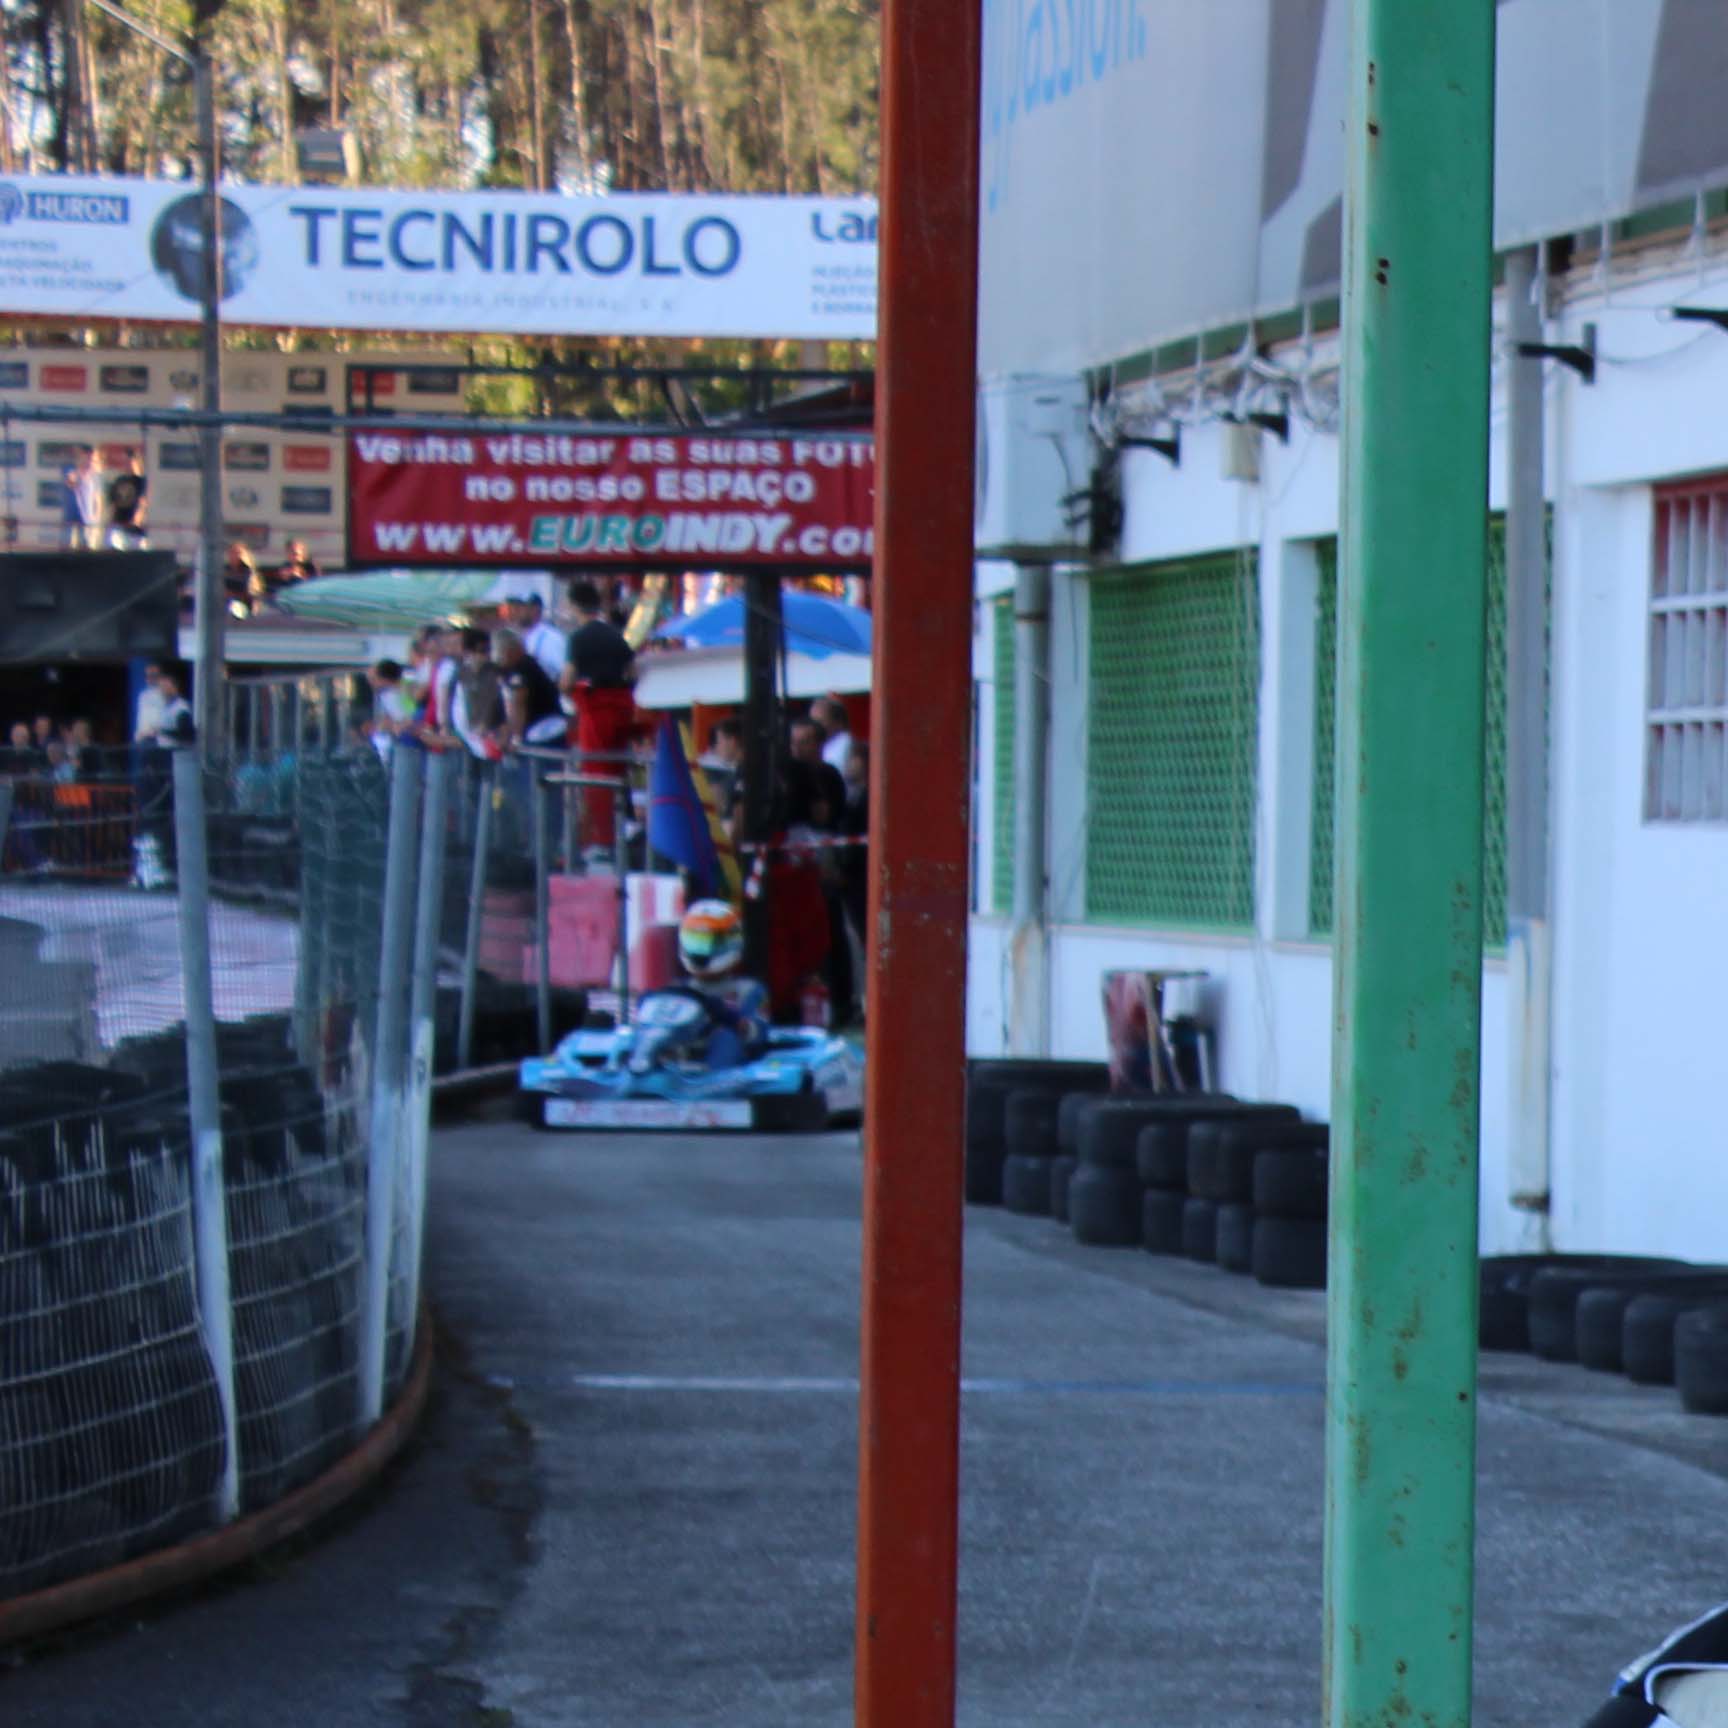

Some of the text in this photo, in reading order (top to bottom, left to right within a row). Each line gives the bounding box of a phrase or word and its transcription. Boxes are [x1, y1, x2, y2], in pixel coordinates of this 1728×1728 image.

[34, 194, 123, 221] HURON
[288, 205, 742, 278] TECNIROLO
[355, 433, 475, 464] Venha
[485, 434, 616, 465] visitar
[628, 438, 677, 464] as
[687, 439, 784, 465] suas
[465, 469, 816, 509] no nosso ESPAÇO
